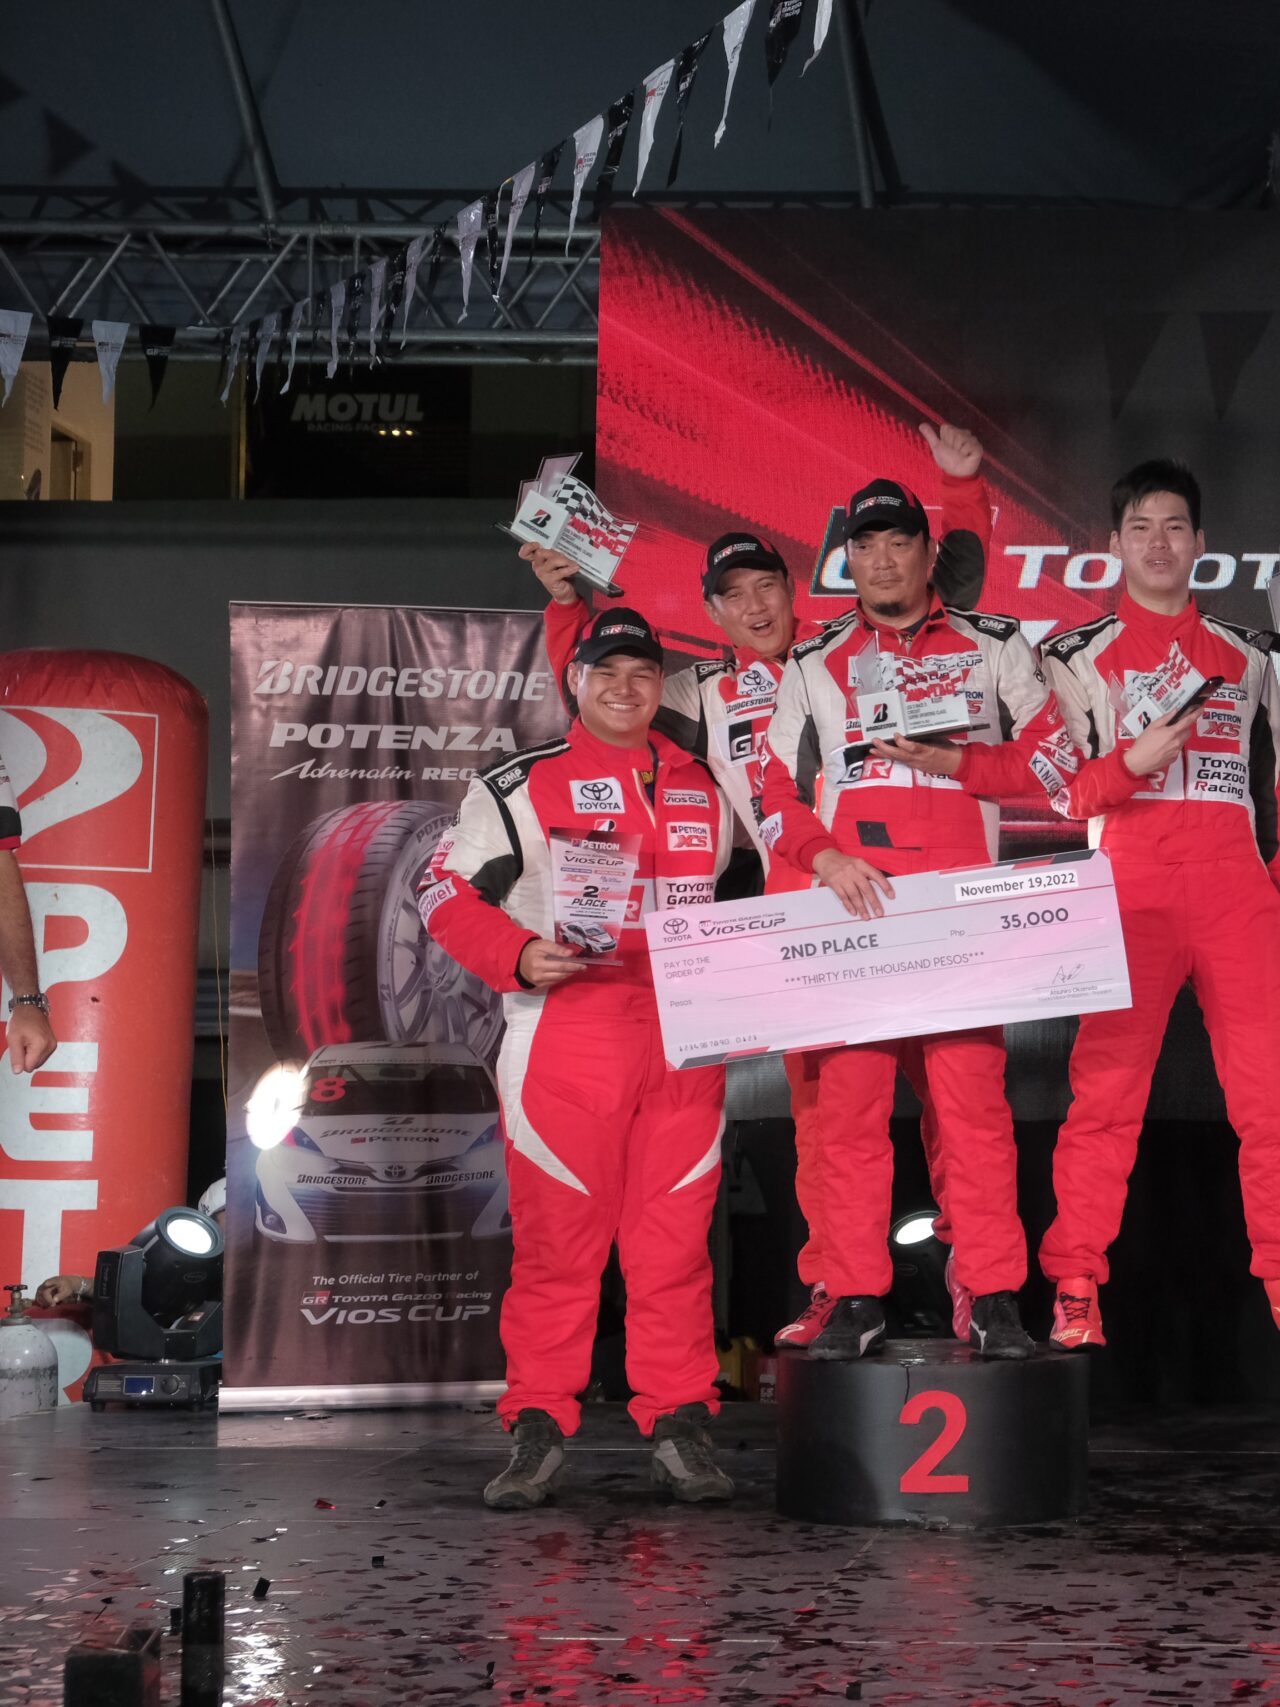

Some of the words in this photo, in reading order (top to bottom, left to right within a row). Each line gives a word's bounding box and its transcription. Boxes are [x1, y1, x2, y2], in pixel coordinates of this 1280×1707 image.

[291, 394, 424, 421] MOTUL
[978, 619, 1006, 631] OMP
[1057, 634, 1082, 650] OMP
[253, 660, 553, 701] BRIDGESTONE
[1211, 712, 1242, 724] PETRON
[269, 721, 517, 752] POTENZA
[1203, 722, 1241, 737] XCS
[270, 758, 414, 782] Adrenalin
[421, 767, 481, 781] RE0
[1199, 757, 1247, 773] TOYOTA
[498, 767, 522, 787] OMP
[1197, 769, 1245, 785] GAZOO
[1195, 781, 1244, 799] Racing
[577, 802, 621, 811] TOYOTA
[677, 825, 707, 835] PETRON
[581, 840, 620, 851] PETRON
[673, 835, 708, 848] XCS
[564, 855, 596, 865] VIOS
[598, 858, 624, 867] CUP
[960, 880, 1024, 897] November
[1028, 873, 1077, 889] 19,2022
[572, 898, 608, 908] PLACE
[666, 894, 713, 906] GAZOO
[1000, 907, 1069, 930] 35,000
[700, 924, 746, 936] VIOS
[748, 918, 786, 930] CUP
[663, 934, 692, 943] TOYOTA
[780, 943, 817, 961] 2ND
[821, 933, 879, 954] PLACE
[843, 967, 866, 980] FIVE
[868, 958, 931, 976] THOUSAND
[310, 1077, 346, 1101] 8
[320, 1127, 473, 1138] BRIDGESTONE
[368, 1136, 440, 1144] PETRON
[297, 1173, 368, 1186] BRIDGESTONE
[425, 1170, 495, 1185] BRIDGESTONE
[312, 1276, 335, 1286] The
[338, 1273, 385, 1285] Official
[388, 1273, 412, 1283] Tire
[415, 1271, 462, 1282] Partner
[465, 1270, 479, 1281] of
[332, 1294, 389, 1303] TOYOTA
[391, 1292, 442, 1302] GAZOO
[447, 1291, 492, 1301] acing
[300, 1307, 402, 1326] VIOS
[407, 1304, 491, 1322] CUP
[899, 1390, 968, 1493] 2
